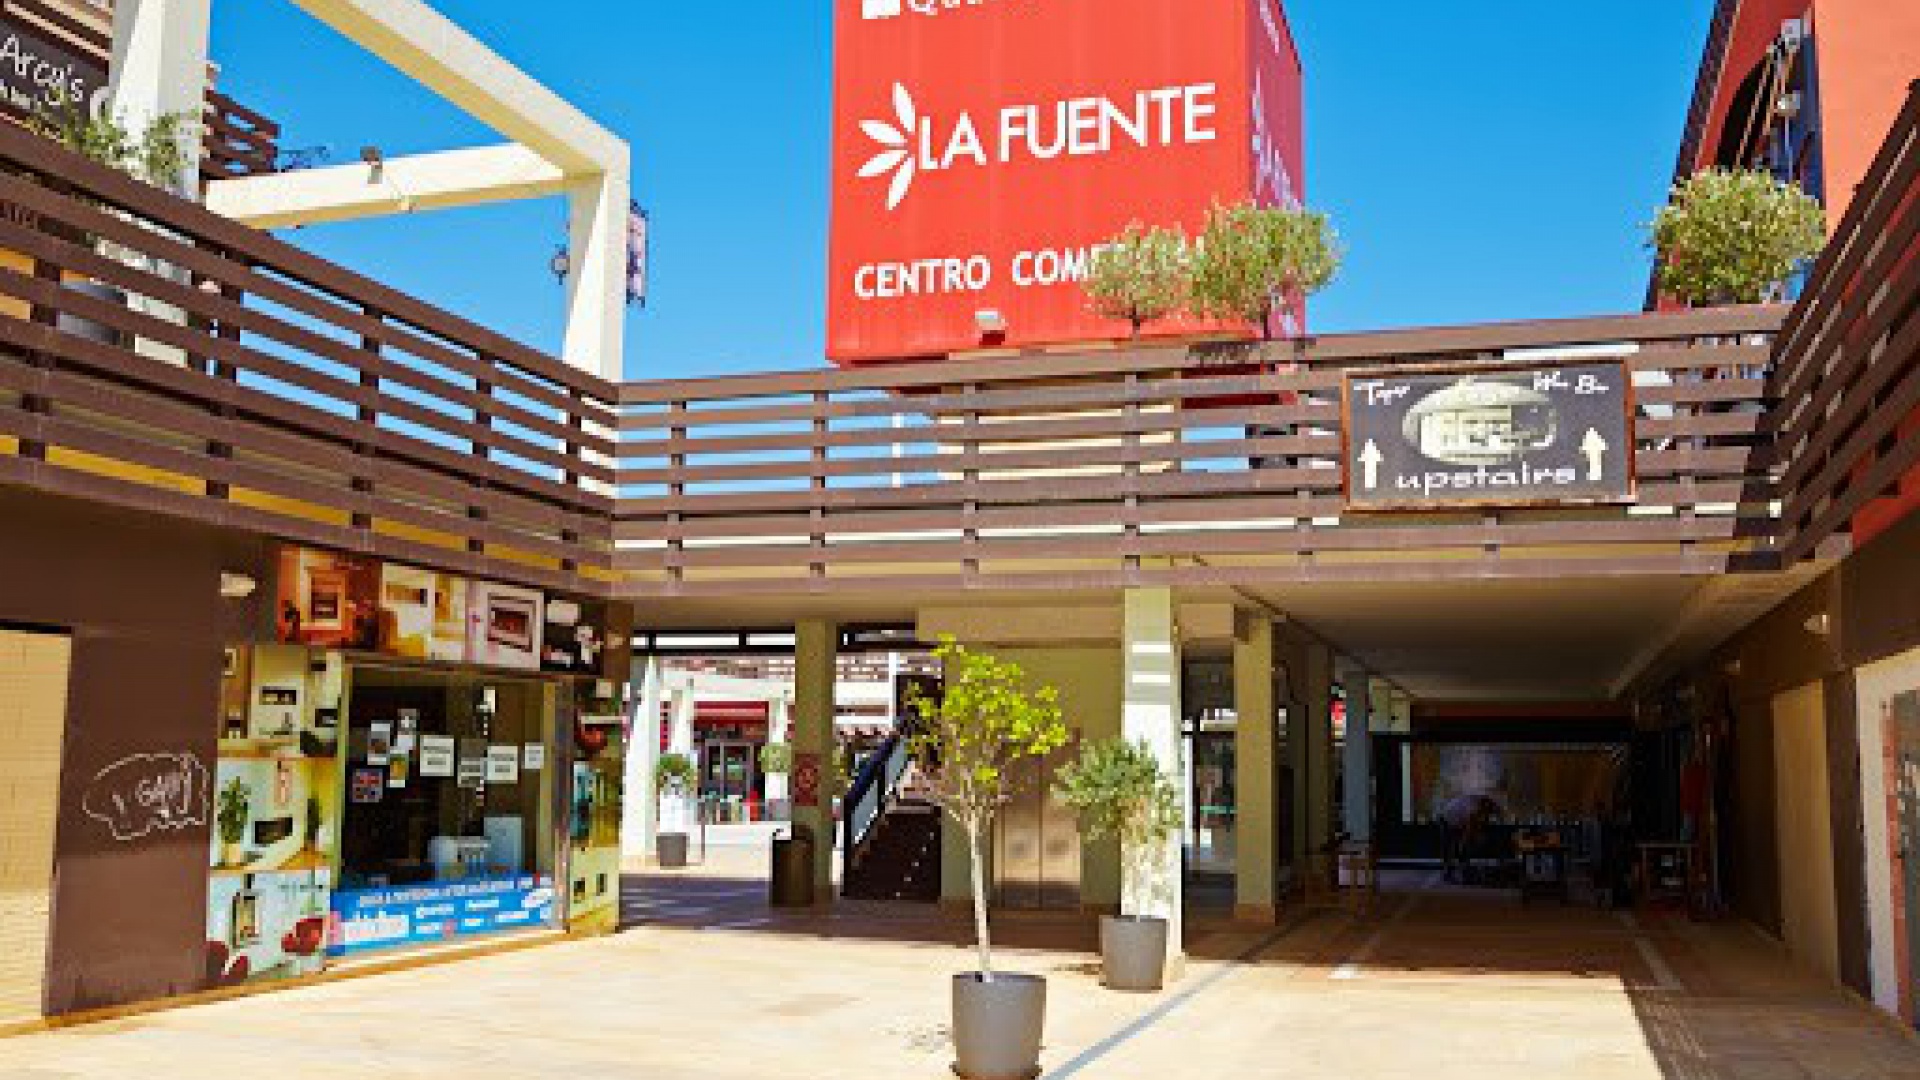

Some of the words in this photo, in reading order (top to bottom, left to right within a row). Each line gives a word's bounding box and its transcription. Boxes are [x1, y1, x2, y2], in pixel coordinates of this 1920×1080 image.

[918, 109, 987, 170] LA
[999, 82, 1217, 163] FUENTE
[854, 255, 991, 299] CENTRO
[1395, 462, 1576, 496] upstairs
